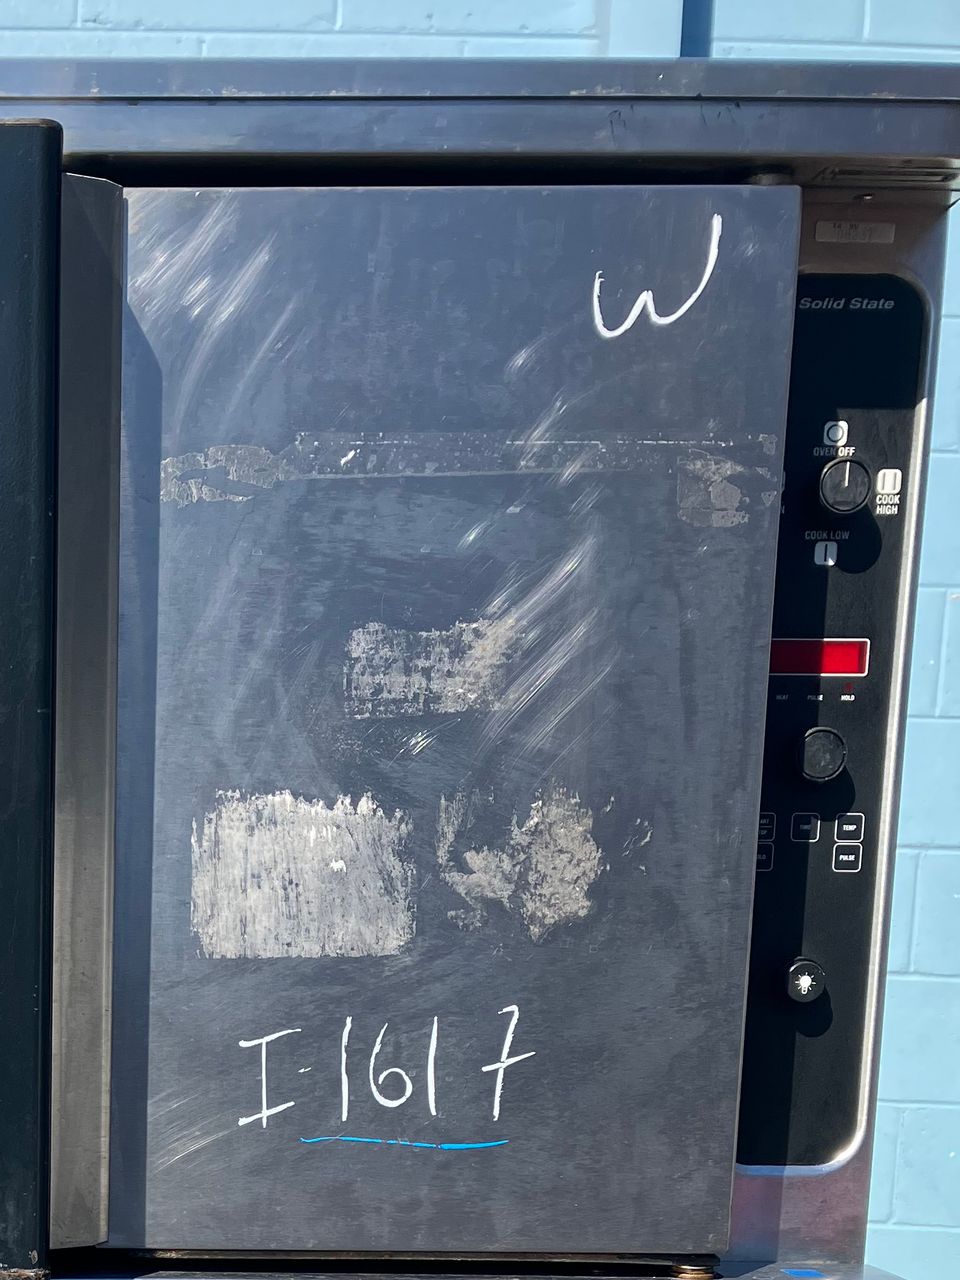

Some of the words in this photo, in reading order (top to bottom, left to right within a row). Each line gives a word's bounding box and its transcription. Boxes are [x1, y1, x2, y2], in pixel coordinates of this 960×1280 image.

[799, 297, 844, 310] Solid
[850, 297, 895, 310] State
[813, 447, 837, 457] OVEN
[838, 446, 856, 457] OFF
[876, 494, 900, 505] COOK
[876, 504, 898, 515] HIGH
[805, 530, 828, 540] COOK
[830, 530, 850, 540] LOW
